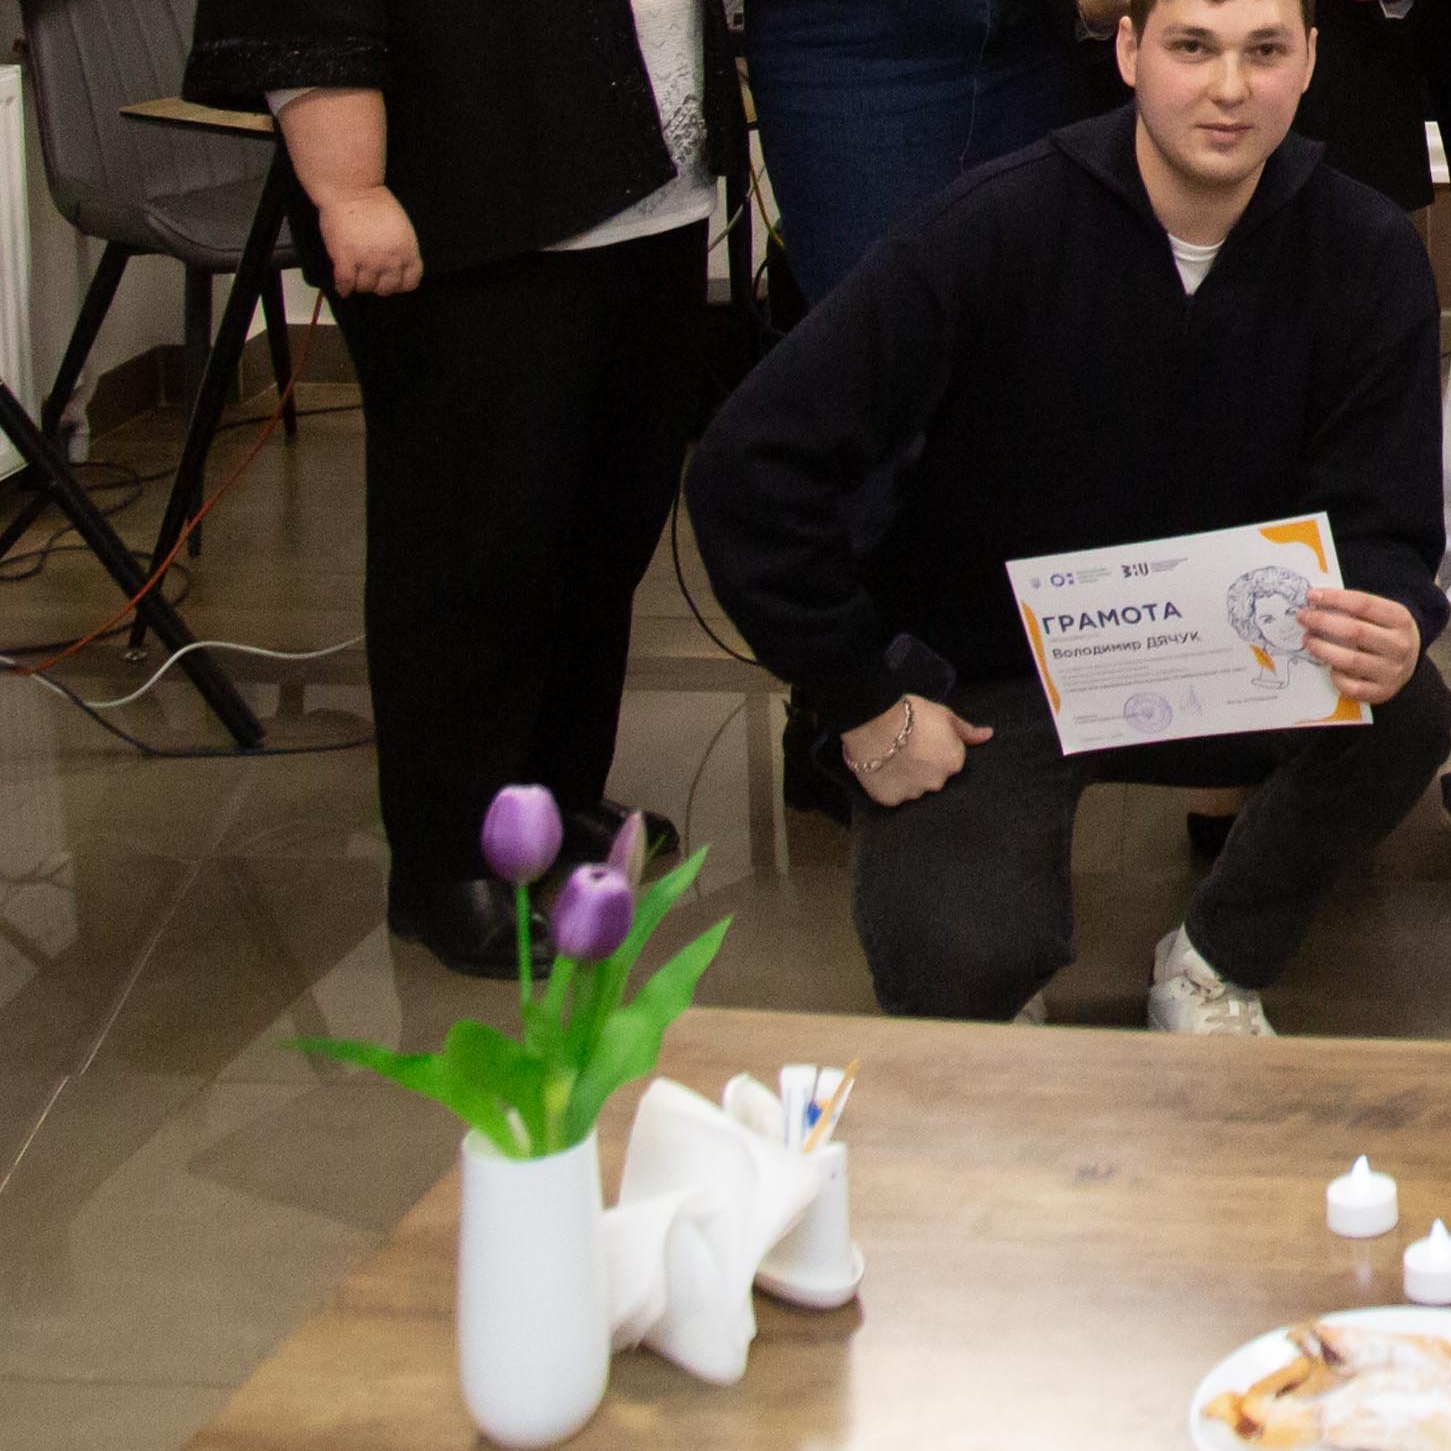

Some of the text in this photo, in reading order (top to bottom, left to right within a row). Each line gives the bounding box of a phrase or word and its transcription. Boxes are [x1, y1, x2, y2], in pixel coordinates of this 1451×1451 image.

[1042, 601, 1183, 635] ГРАМОТА
[1052, 631, 1201, 660] Володимир ДЯЧУК
